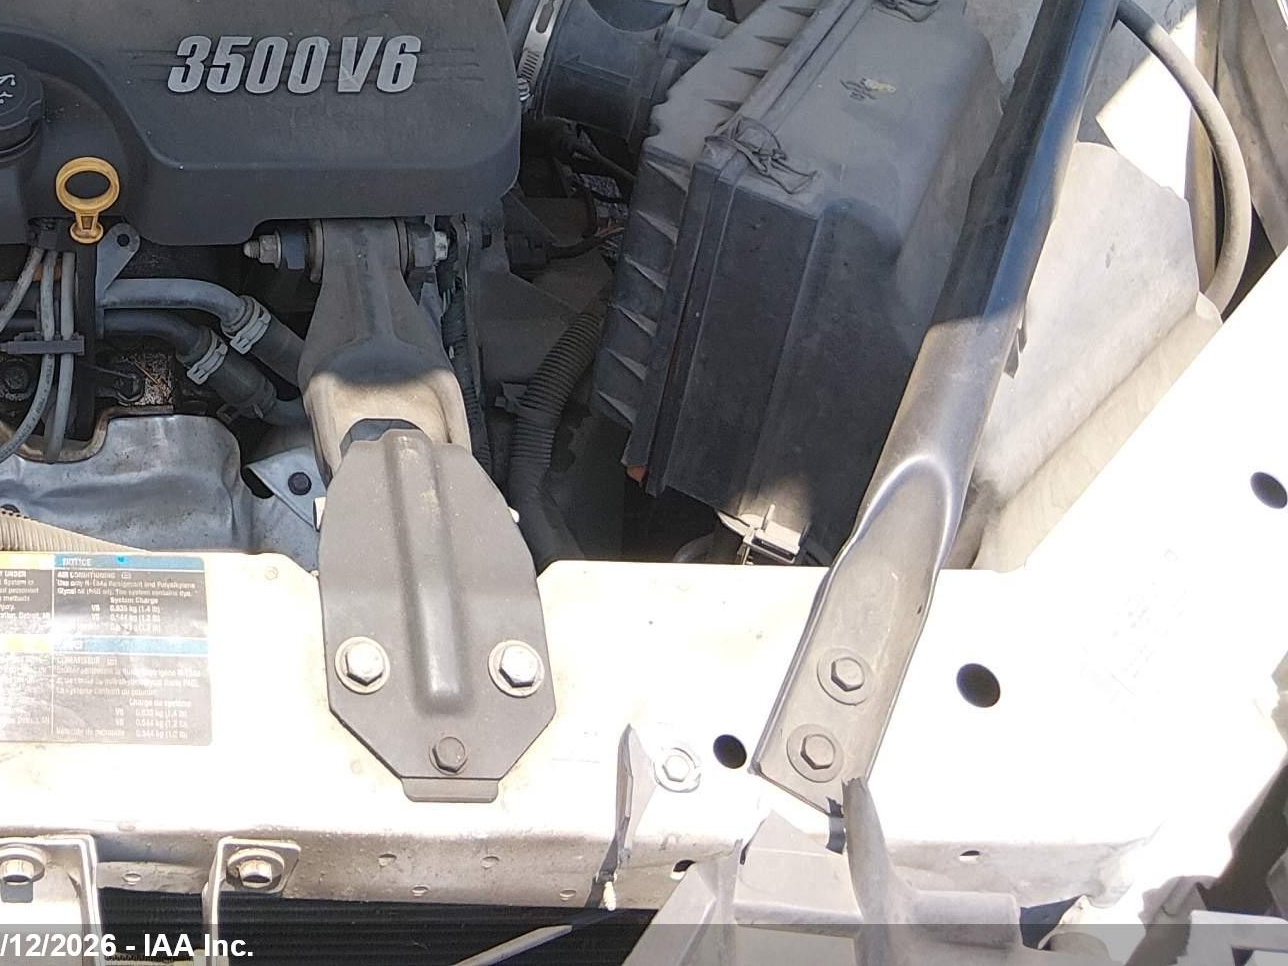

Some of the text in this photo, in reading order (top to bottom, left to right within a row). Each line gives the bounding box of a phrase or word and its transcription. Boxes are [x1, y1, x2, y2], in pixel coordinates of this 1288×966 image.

[167, 35, 422, 94] 3500 V6
[63, 558, 91, 566] NOTICE
